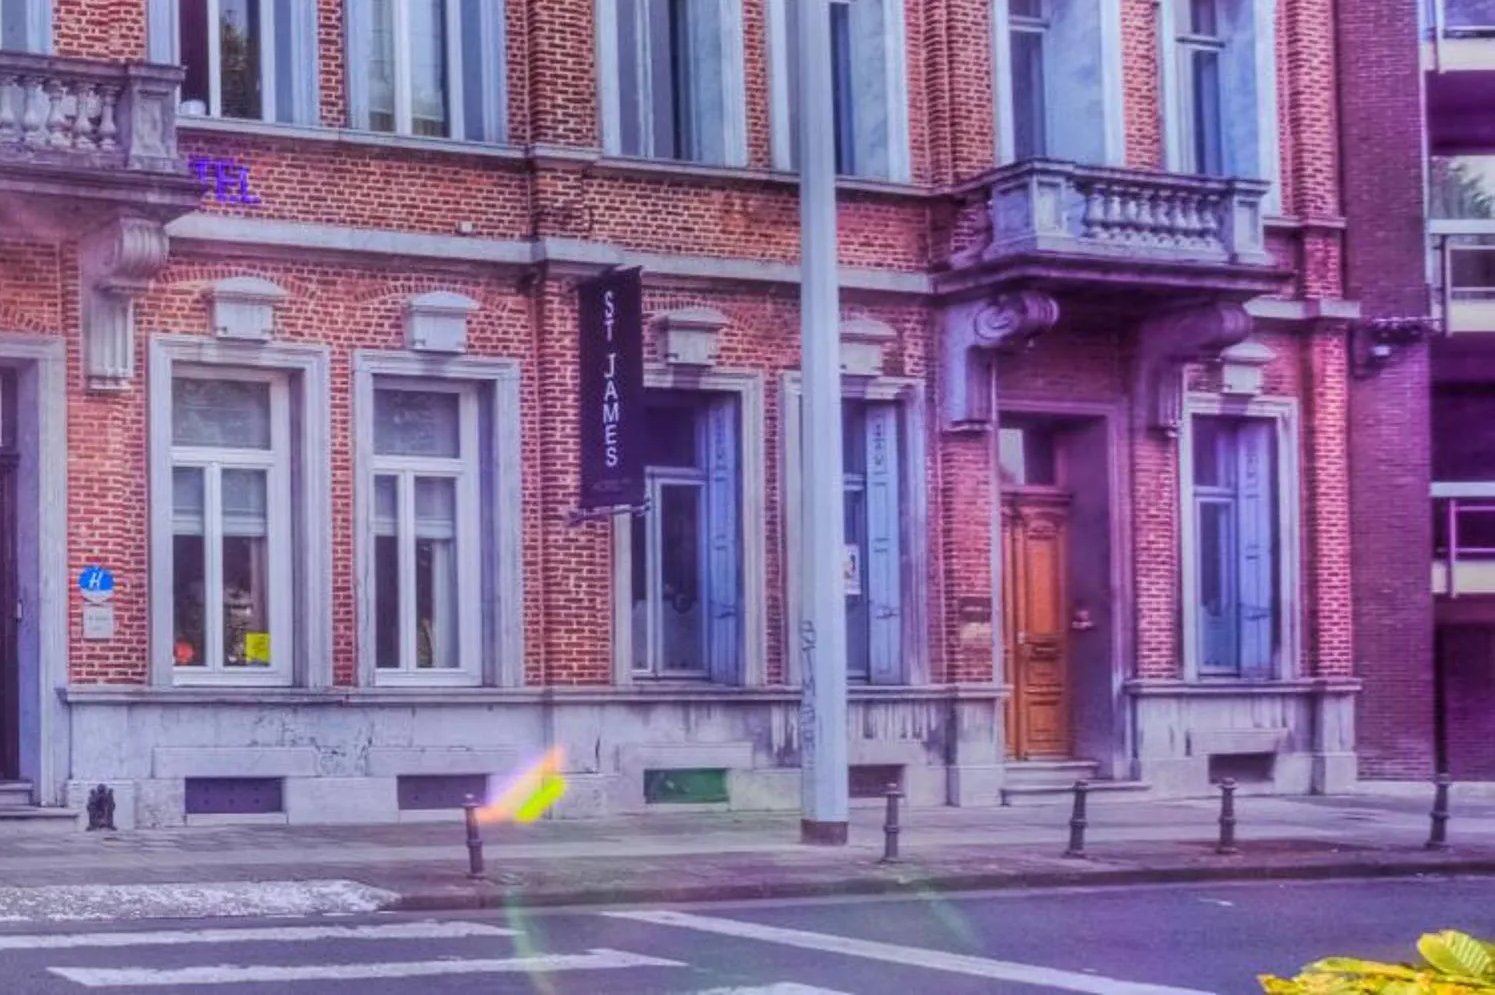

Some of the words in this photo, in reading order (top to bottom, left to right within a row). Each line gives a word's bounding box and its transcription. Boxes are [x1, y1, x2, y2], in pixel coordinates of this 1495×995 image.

[188, 156, 262, 204] TEL
[604, 290, 614, 341] ST
[603, 353, 620, 467] JAMES
